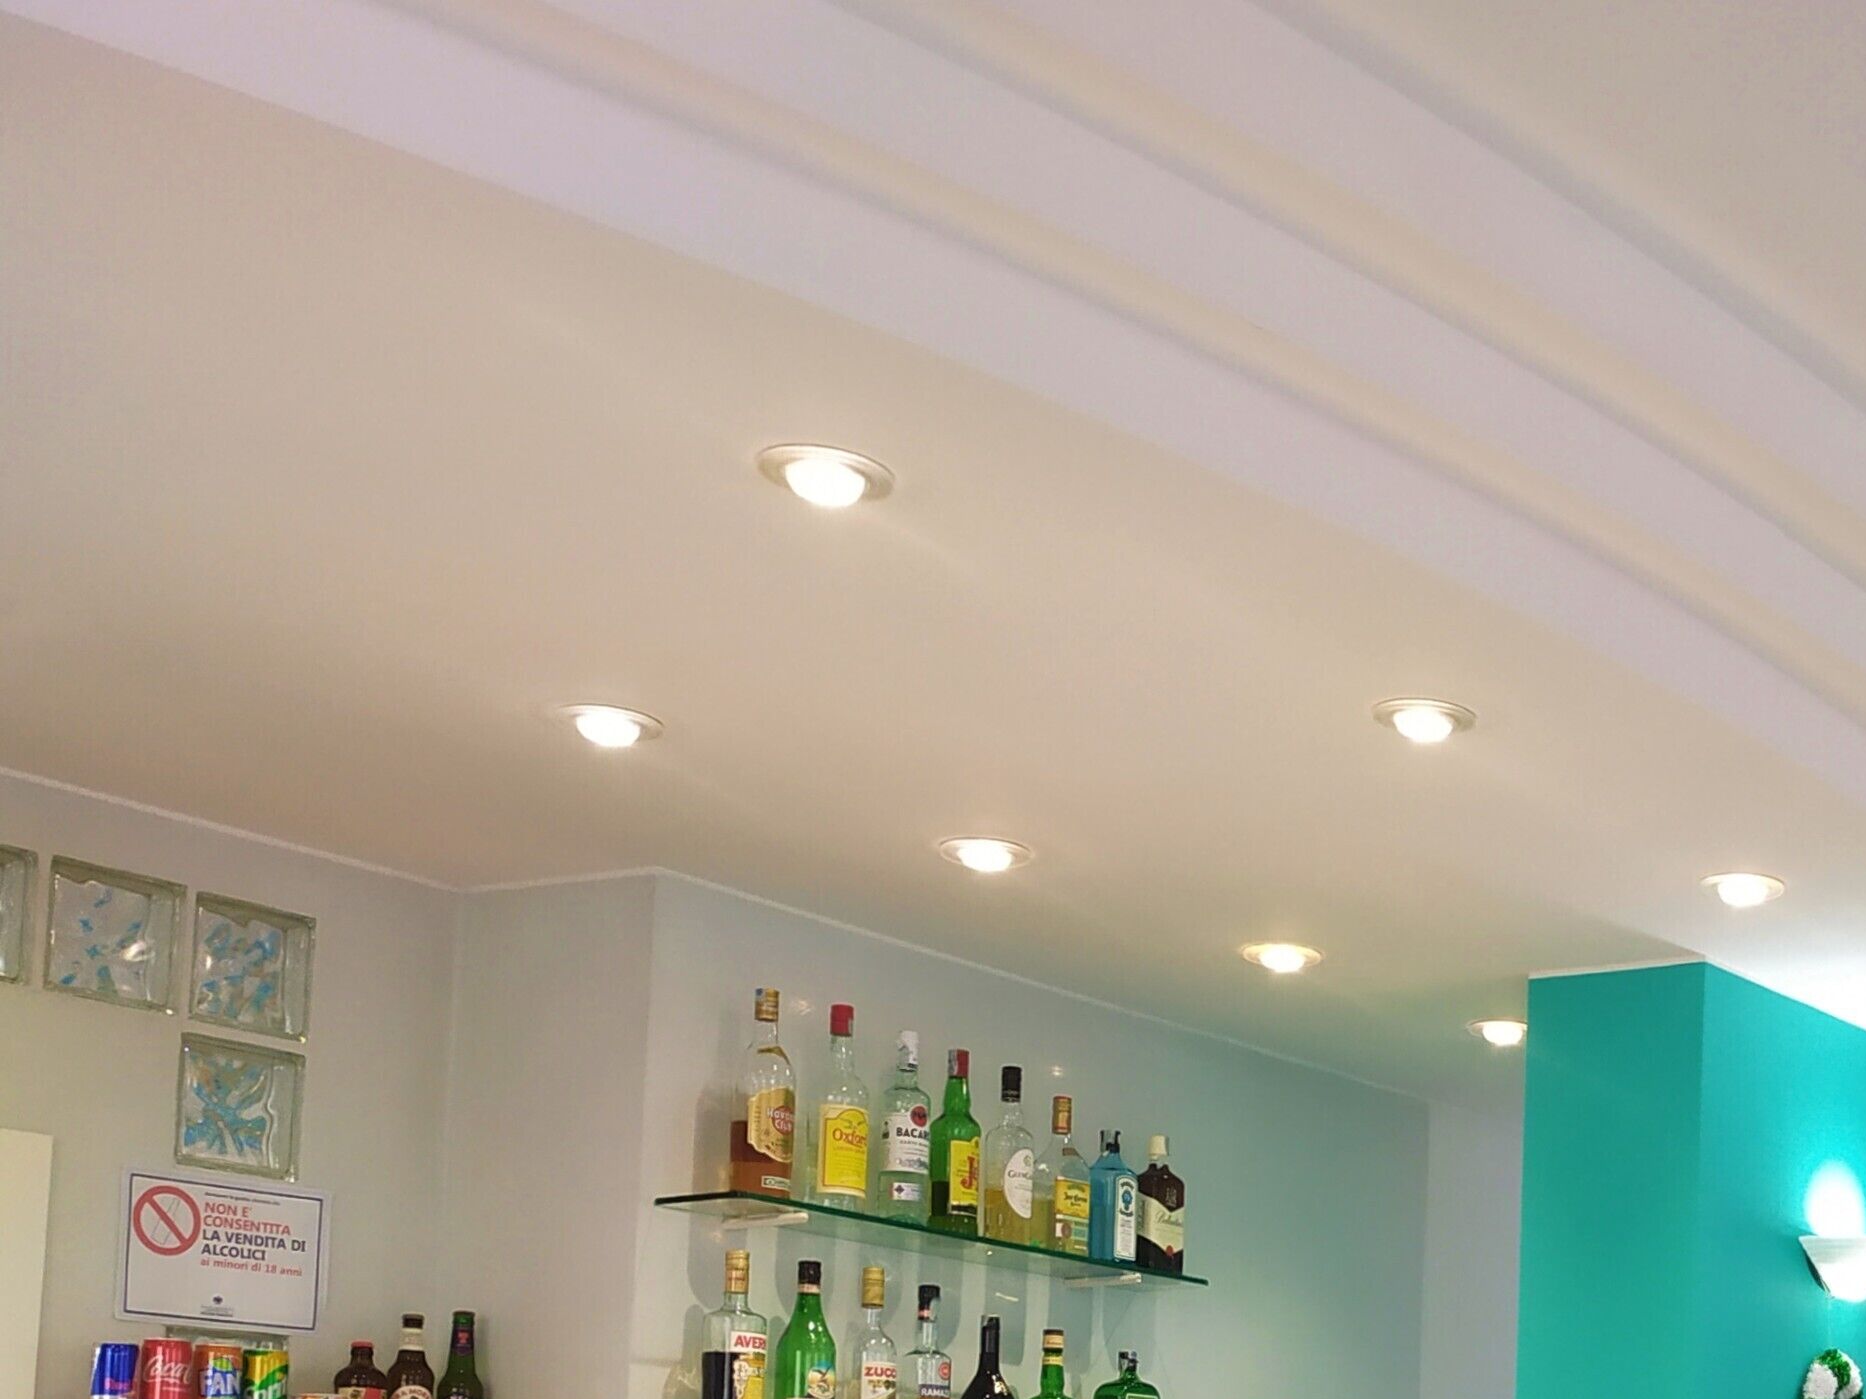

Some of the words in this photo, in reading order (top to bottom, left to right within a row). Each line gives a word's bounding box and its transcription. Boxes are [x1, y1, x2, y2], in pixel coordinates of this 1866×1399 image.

[204, 1201, 239, 1216] NON
[203, 1214, 291, 1236] CONSENTITA
[202, 1229, 221, 1242] LA
[225, 1231, 286, 1250] VENDITA
[291, 1240, 306, 1252] DI
[201, 1243, 266, 1261] ALCOLICI
[200, 1258, 210, 1267] ai
[213, 1258, 249, 1271] minori
[251, 1261, 262, 1272] di
[265, 1263, 277, 1274] 18
[279, 1266, 303, 1277] anni
